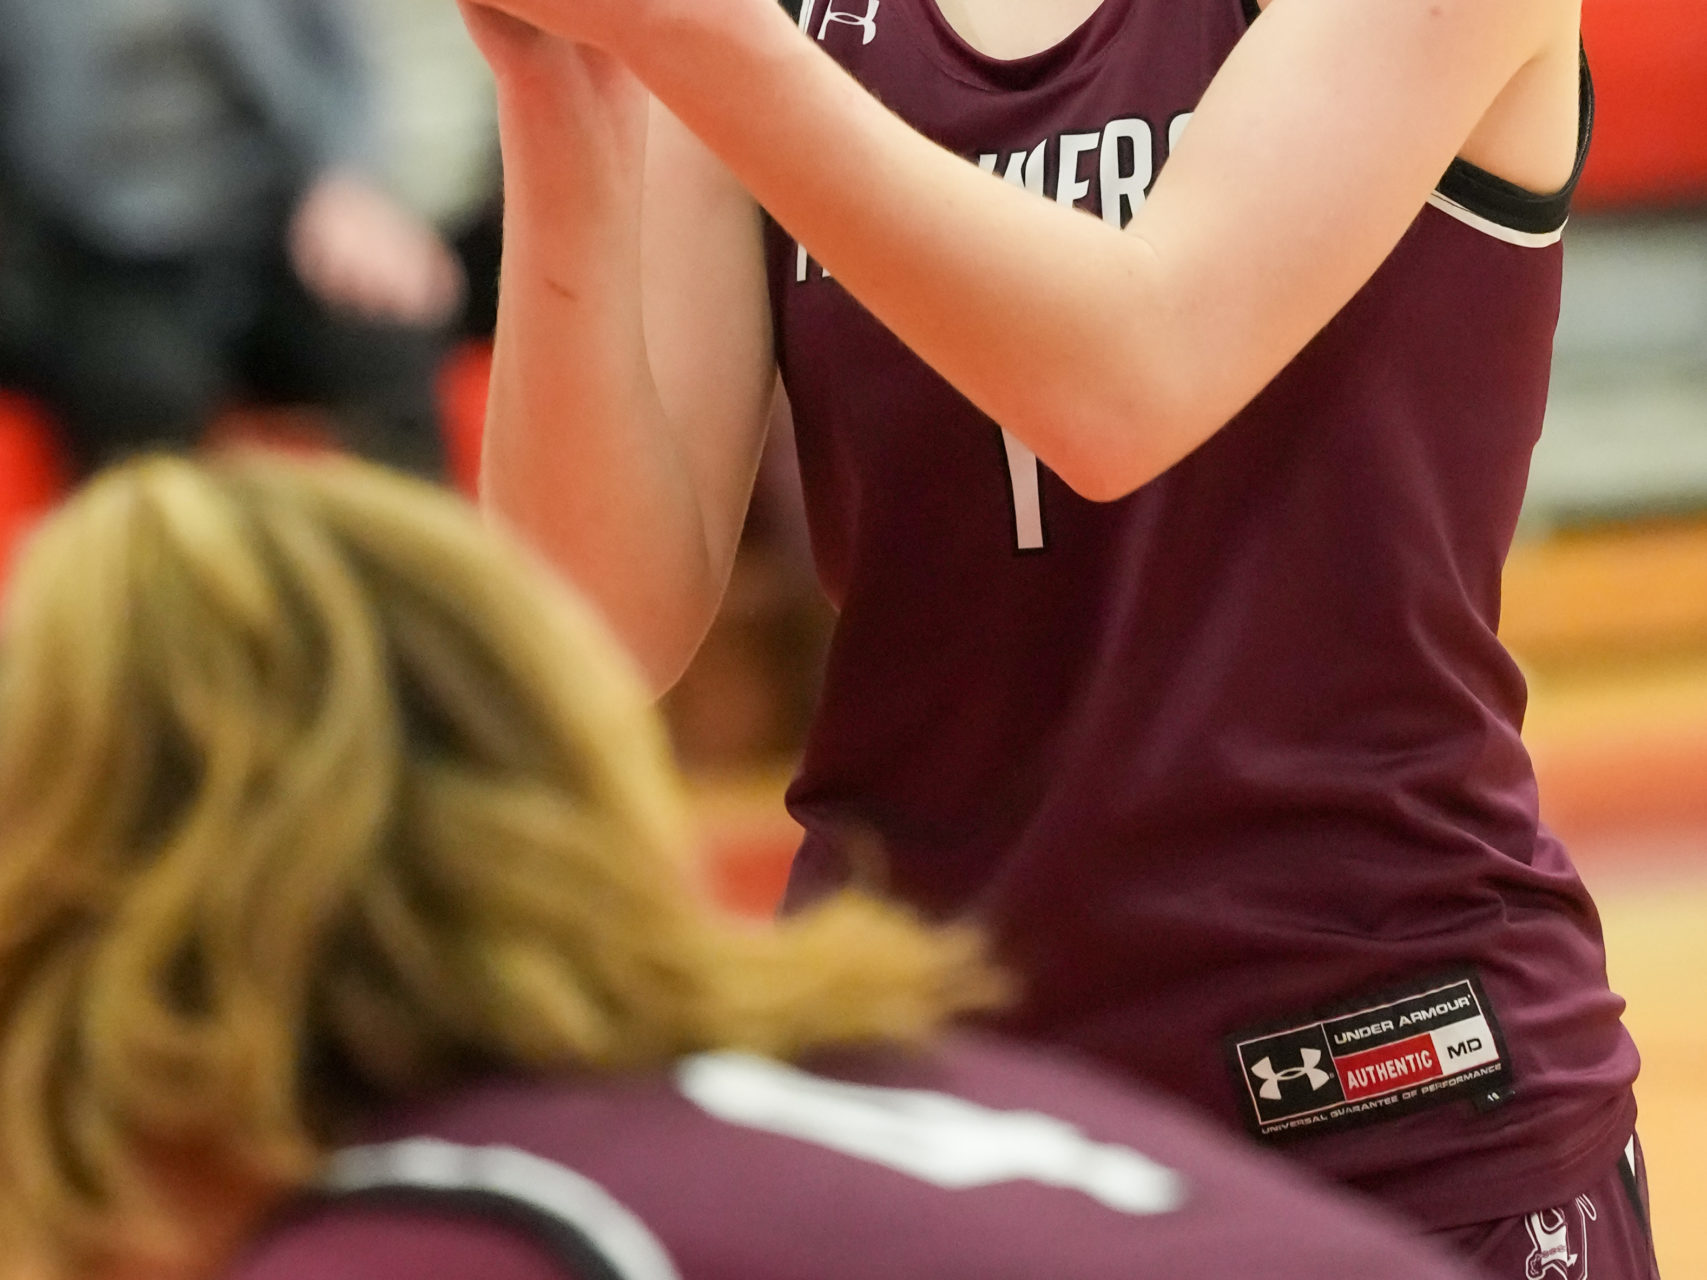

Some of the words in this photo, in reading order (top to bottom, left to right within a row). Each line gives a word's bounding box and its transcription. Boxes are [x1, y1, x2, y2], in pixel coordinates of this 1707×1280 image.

[1334, 1020, 1394, 1045] UNDER
[1399, 996, 1471, 1028] ARMOUR
[1347, 1050, 1433, 1090] AUTHENTIC
[1447, 1037, 1482, 1060] MD
[1261, 1113, 1329, 1135] UNIVERSAL
[1330, 1094, 1399, 1119] GUARANTEE
[1402, 1090, 1418, 1101] OF
[1421, 1062, 1502, 1096] PERFORMANCE
